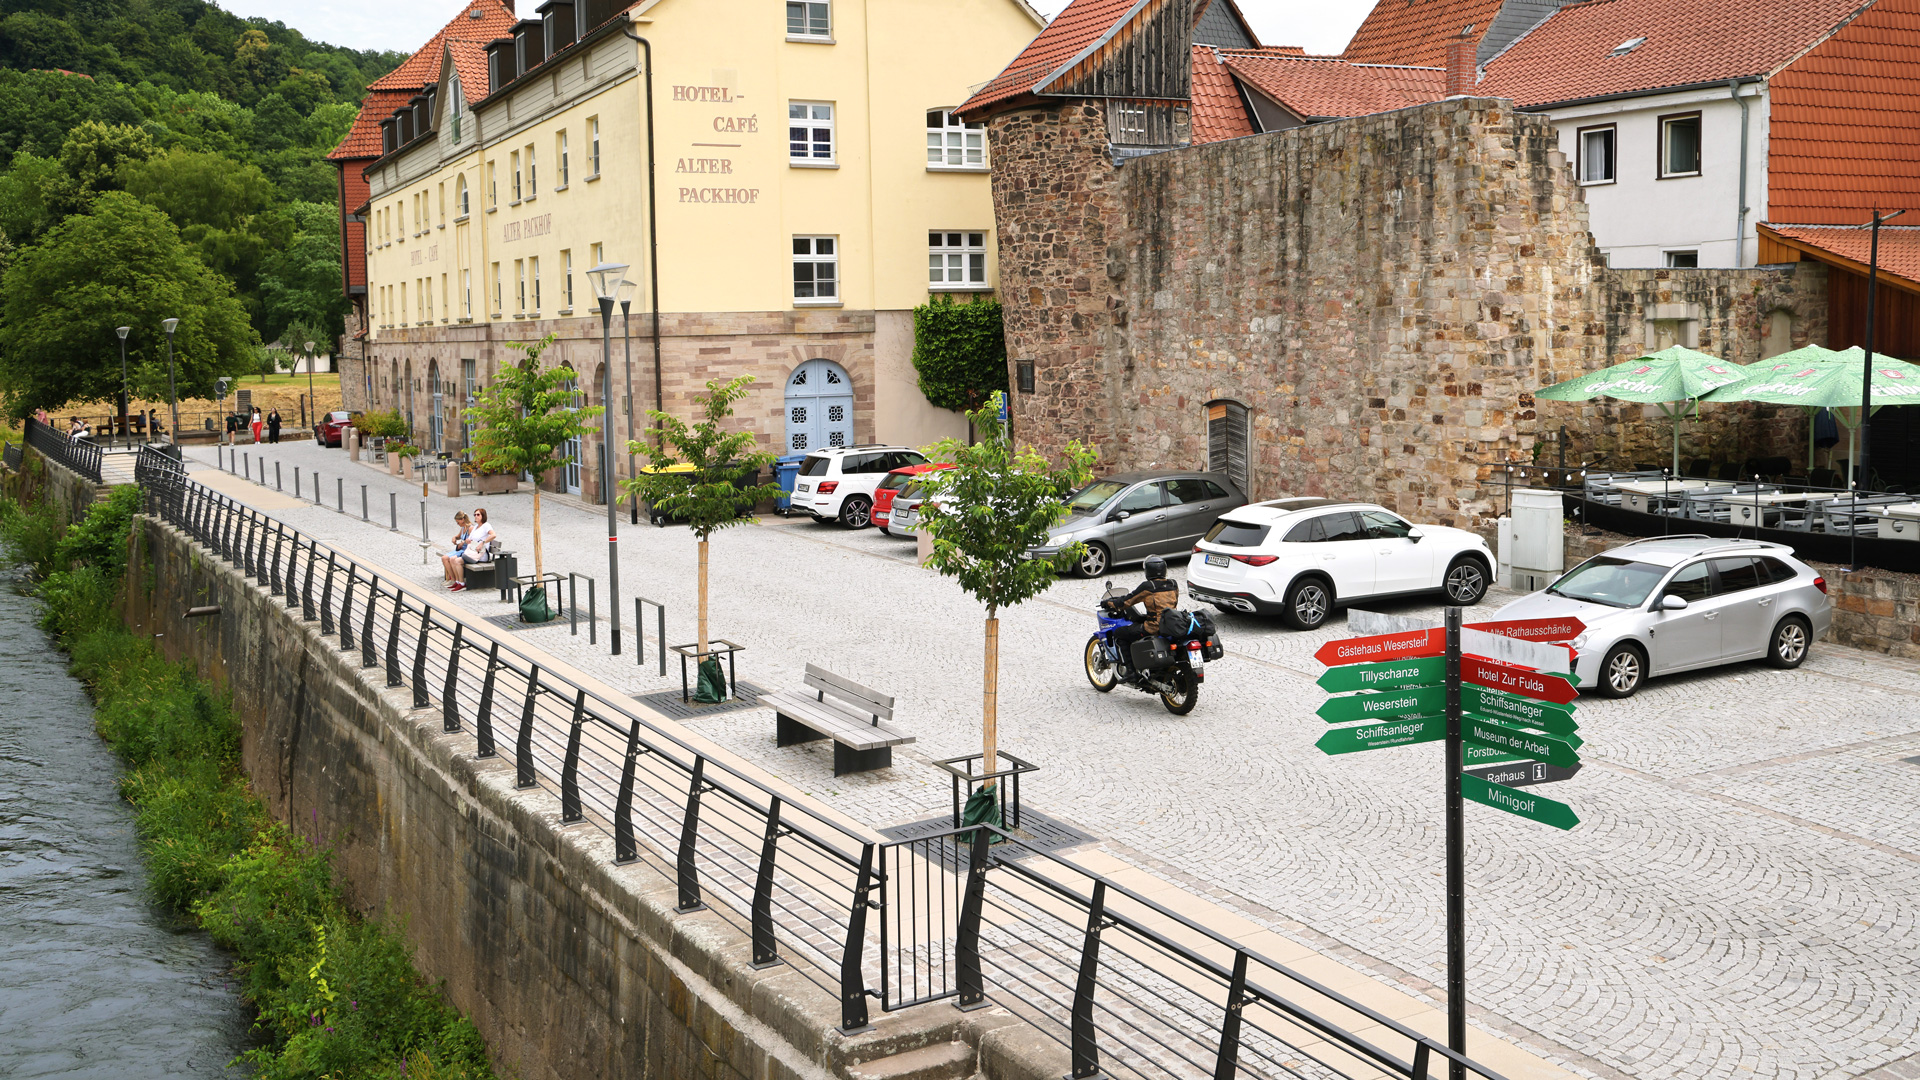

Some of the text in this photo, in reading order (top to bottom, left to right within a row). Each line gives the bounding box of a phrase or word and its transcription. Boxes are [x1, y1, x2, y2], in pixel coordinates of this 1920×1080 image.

[672, 85, 733, 103] HOTEL
[713, 113, 758, 133] CAFÉ
[675, 158, 733, 174] ALTER
[678, 187, 760, 204] PACKHOF
[503, 213, 552, 243] ALTER PACKHOF
[1506, 624, 1572, 638] Rathausschänke
[1337, 636, 1428, 658] Gästehaus Weserstein
[1359, 667, 1419, 684] Tillyschanze
[1477, 667, 1499, 683] Hotel
[1501, 672, 1517, 686] Zur
[1518, 676, 1544, 692] Fulda
[1362, 695, 1418, 712] Weserstein
[1480, 692, 1543, 718] Schiffsanleger
[1356, 722, 1424, 740] Schiffsanleger
[1473, 726, 1550, 756] Museum der Arbeit
[1487, 771, 1526, 783] Rathaus
[1488, 788, 1536, 813] Minigolf
